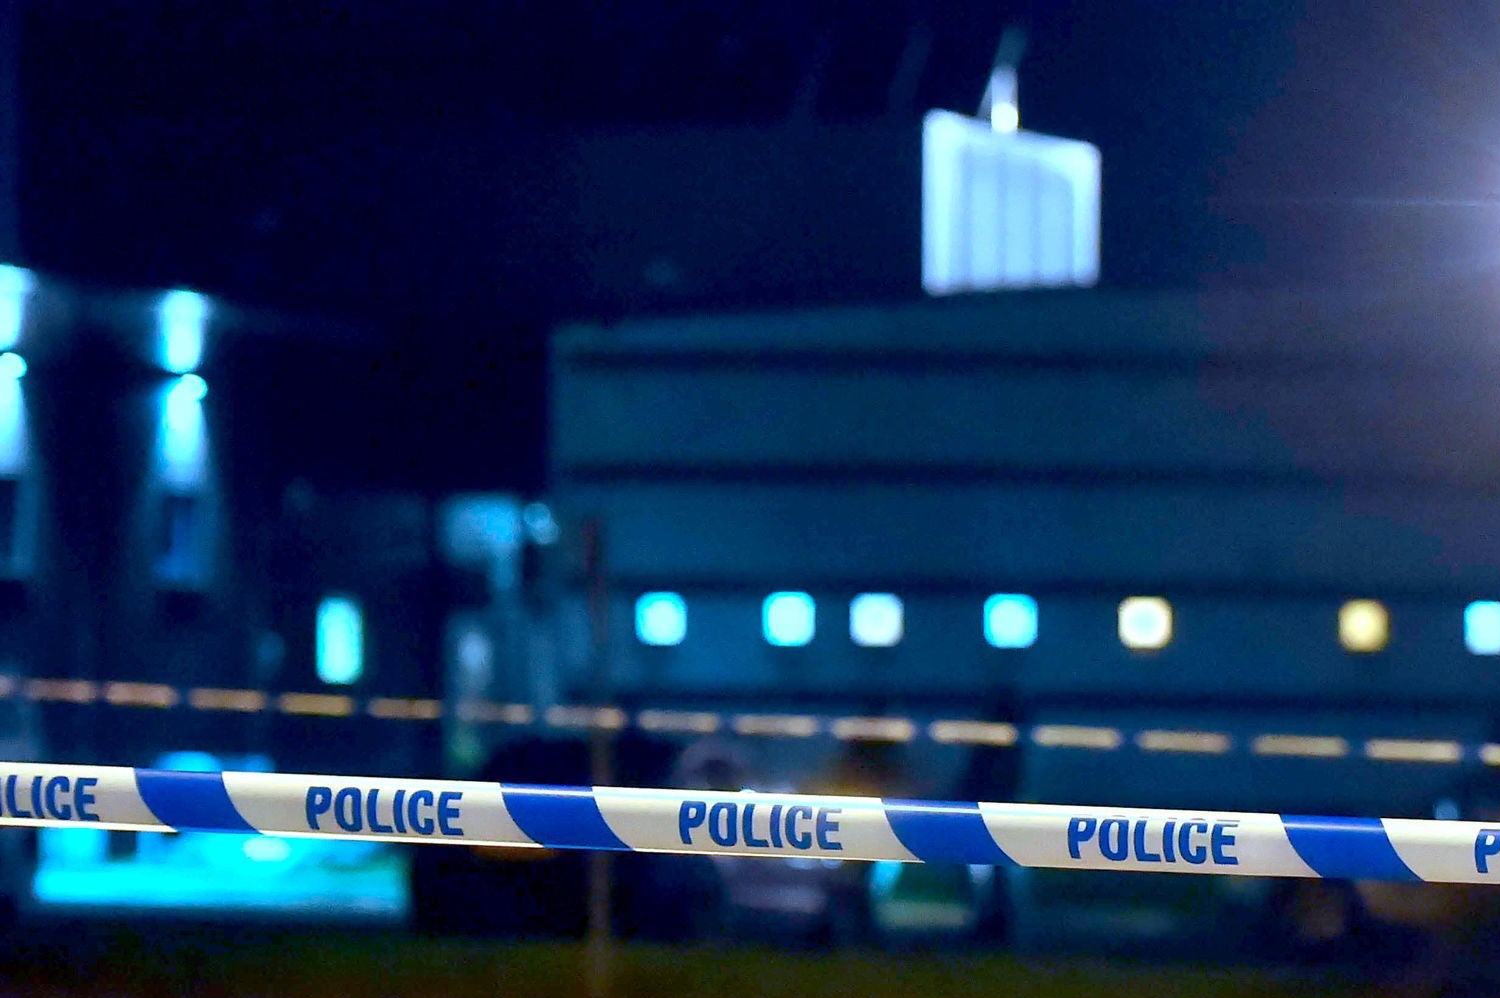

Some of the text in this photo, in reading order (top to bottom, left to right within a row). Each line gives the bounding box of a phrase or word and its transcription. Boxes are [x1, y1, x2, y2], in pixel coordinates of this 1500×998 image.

[0, 774, 102, 823] LICE
[304, 786, 465, 837] POLICE
[678, 800, 844, 851] POLICE
[1067, 812, 1239, 866] POLICE
